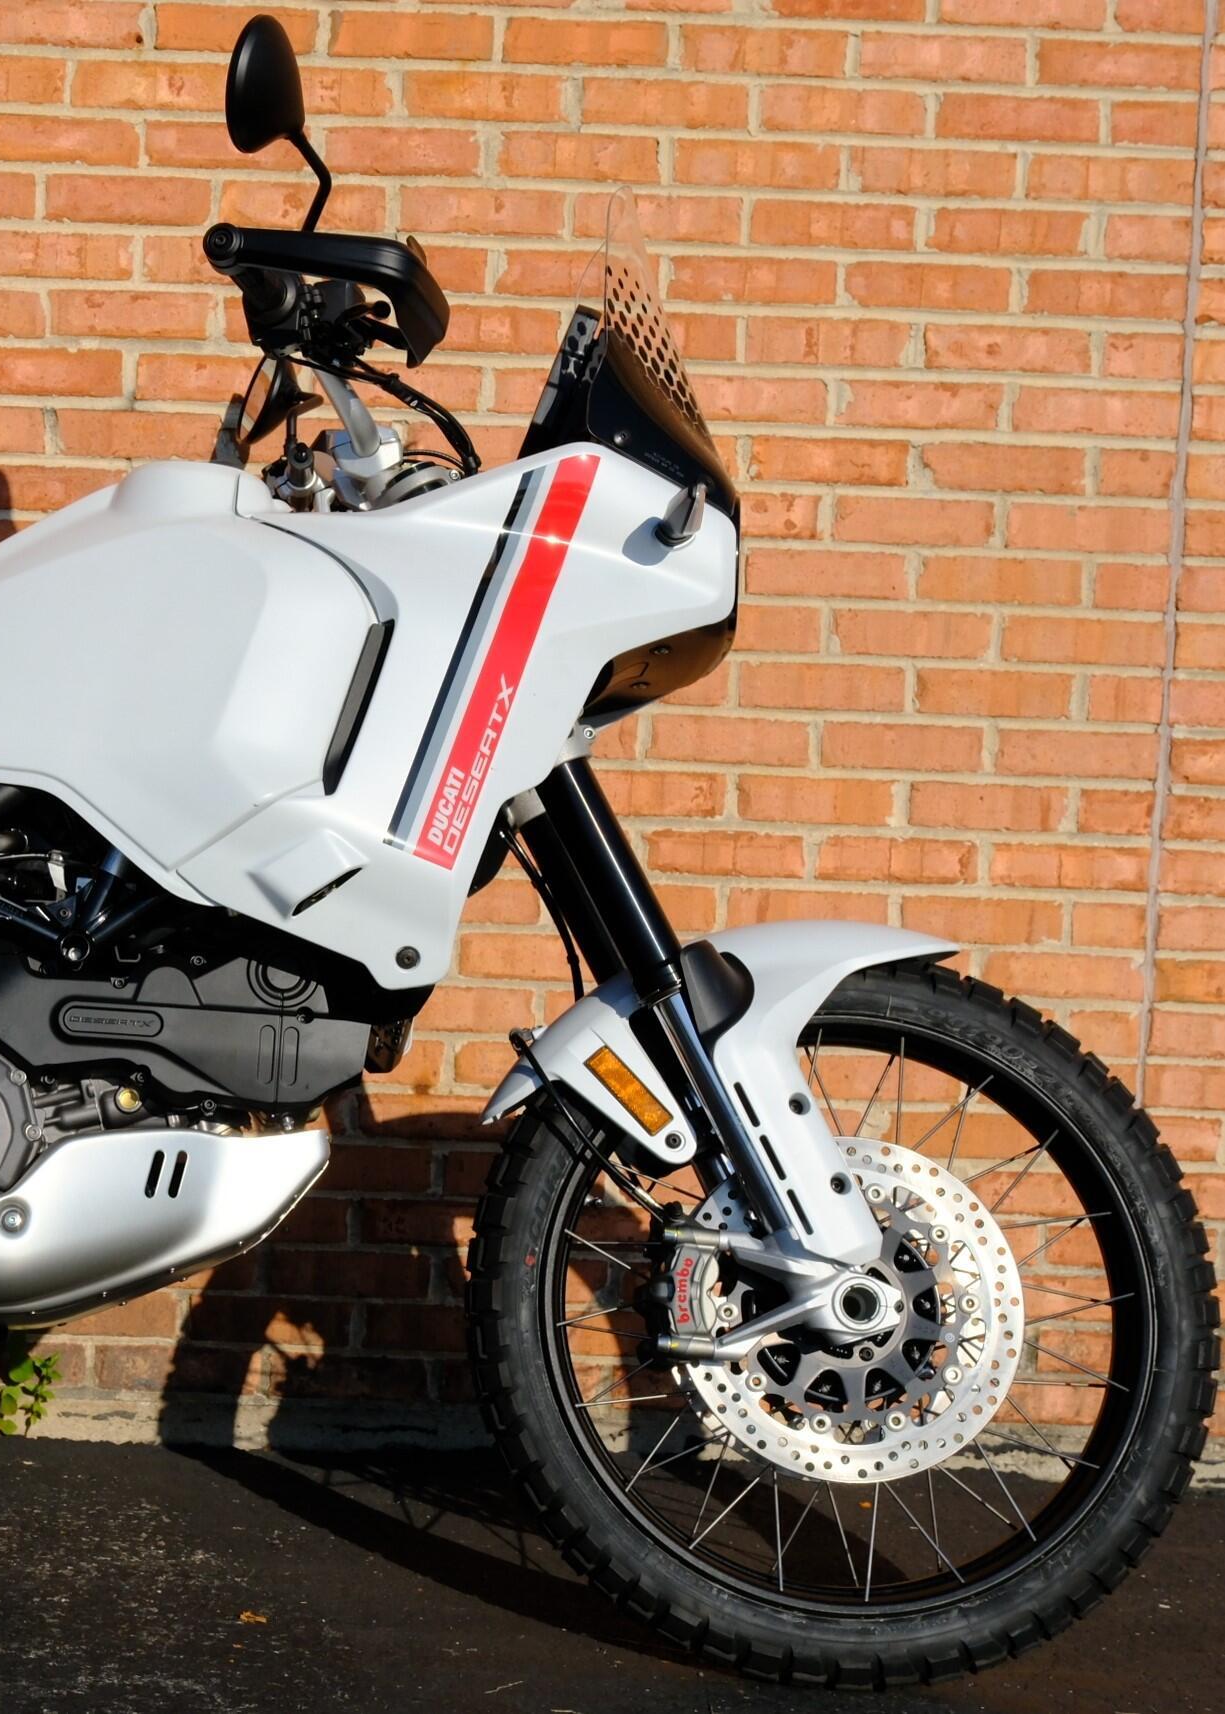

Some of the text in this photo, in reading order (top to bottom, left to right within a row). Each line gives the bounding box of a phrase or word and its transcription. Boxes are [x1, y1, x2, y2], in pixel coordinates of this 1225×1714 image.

[442, 673, 514, 856] DESERTX
[427, 767, 466, 846] DUCATI
[675, 1257, 694, 1324] brembo
